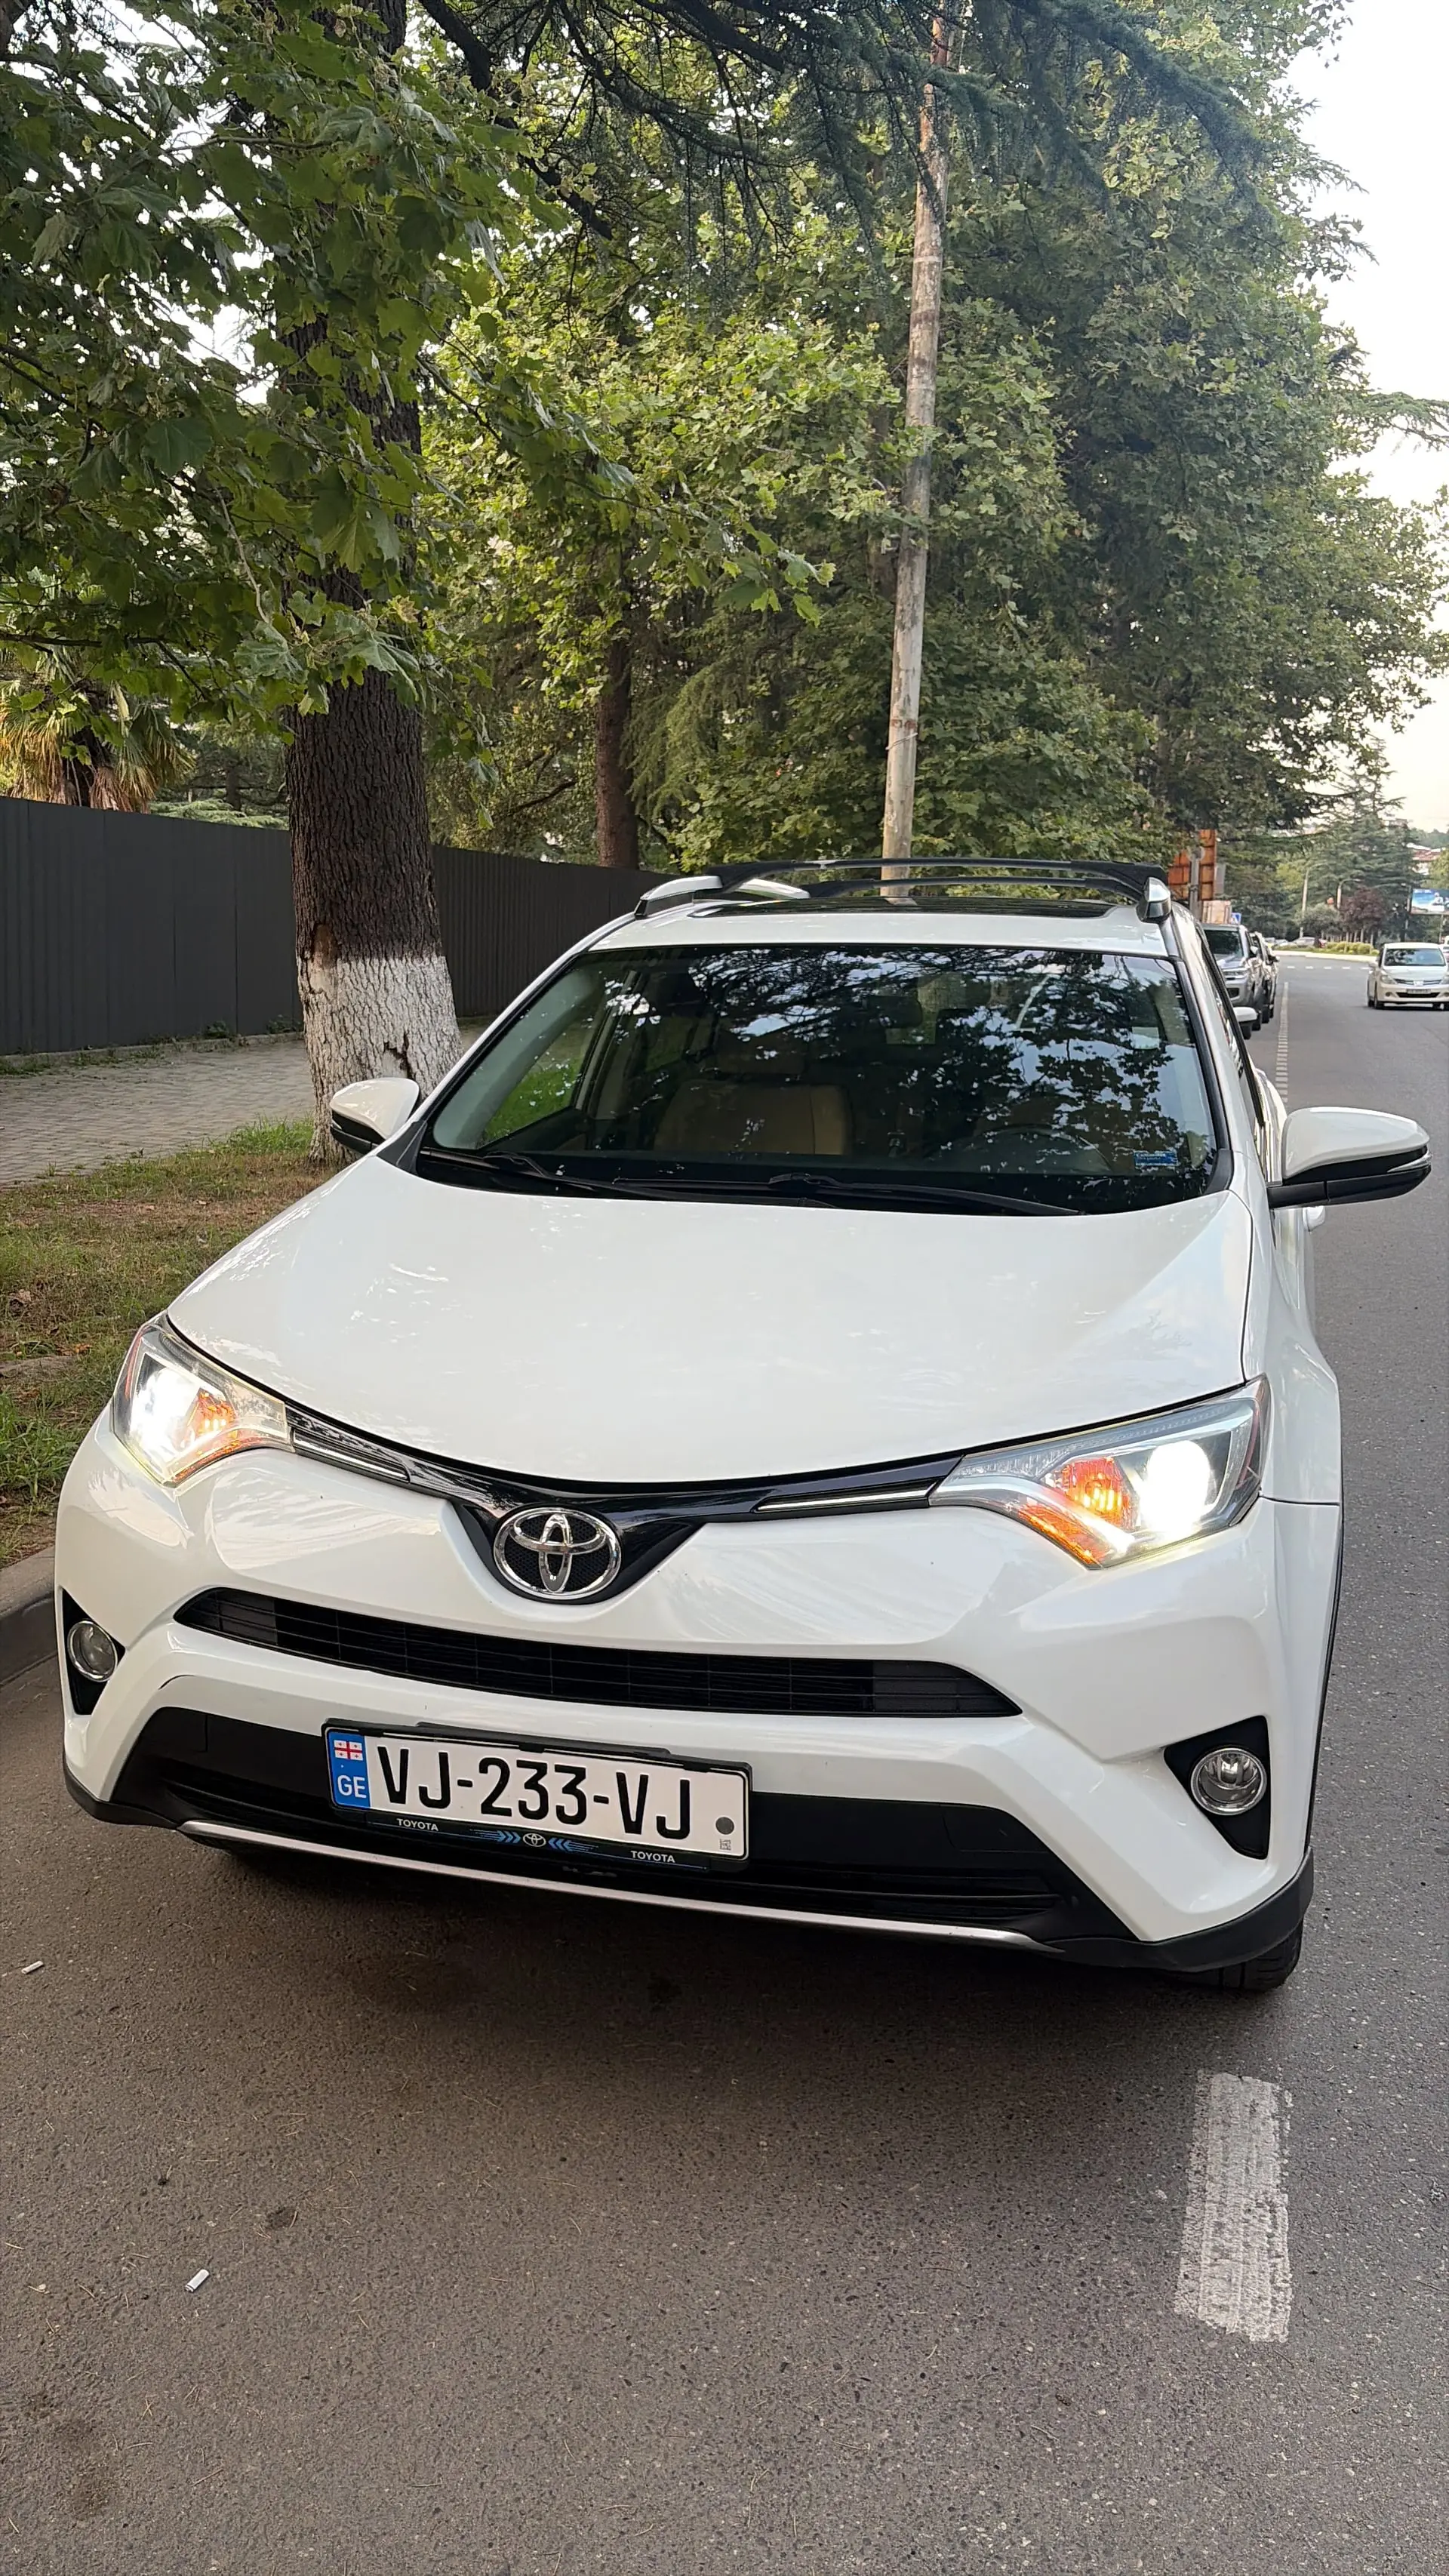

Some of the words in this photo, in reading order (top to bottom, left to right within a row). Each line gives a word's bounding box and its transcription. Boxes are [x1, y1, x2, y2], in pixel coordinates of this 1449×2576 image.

[337, 1774, 367, 1799] GE
[377, 1746, 691, 1840] VJ-233-VJ
[396, 1817, 439, 1832] TOYOTA
[630, 1850, 676, 1864] TOYOTA
